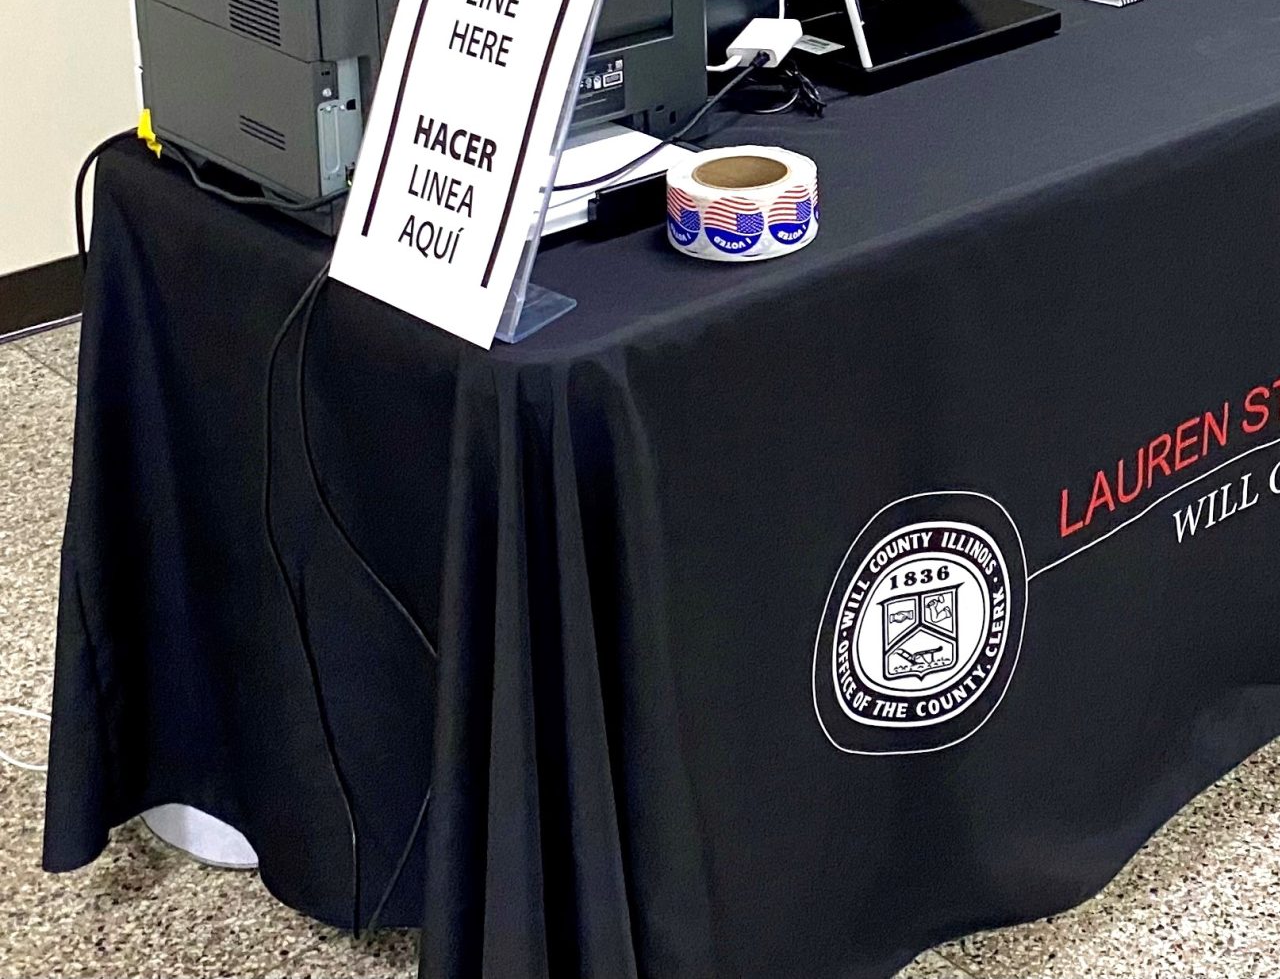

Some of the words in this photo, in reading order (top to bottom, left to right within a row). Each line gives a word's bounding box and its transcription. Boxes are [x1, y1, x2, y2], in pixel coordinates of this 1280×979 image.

[448, 19, 513, 68] HERE
[413, 114, 497, 173] HACER
[408, 163, 475, 219] LINEA
[398, 214, 465, 264] AQUÍ
[713, 236, 746, 250] VOTED
[746, 237, 752, 245] I
[777, 229, 803, 241] VOTED
[1059, 401, 1230, 538] LAUREN
[1172, 474, 1260, 544] WILL
[841, 578, 871, 631] WILL
[869, 530, 934, 574] COUNTY
[940, 532, 996, 575] ILLINOIS
[889, 565, 951, 591] 1836
[837, 640, 854, 701] OFFICE
[852, 691, 872, 712] OF
[872, 699, 909, 719] THE
[985, 585, 1006, 659] CLERK
